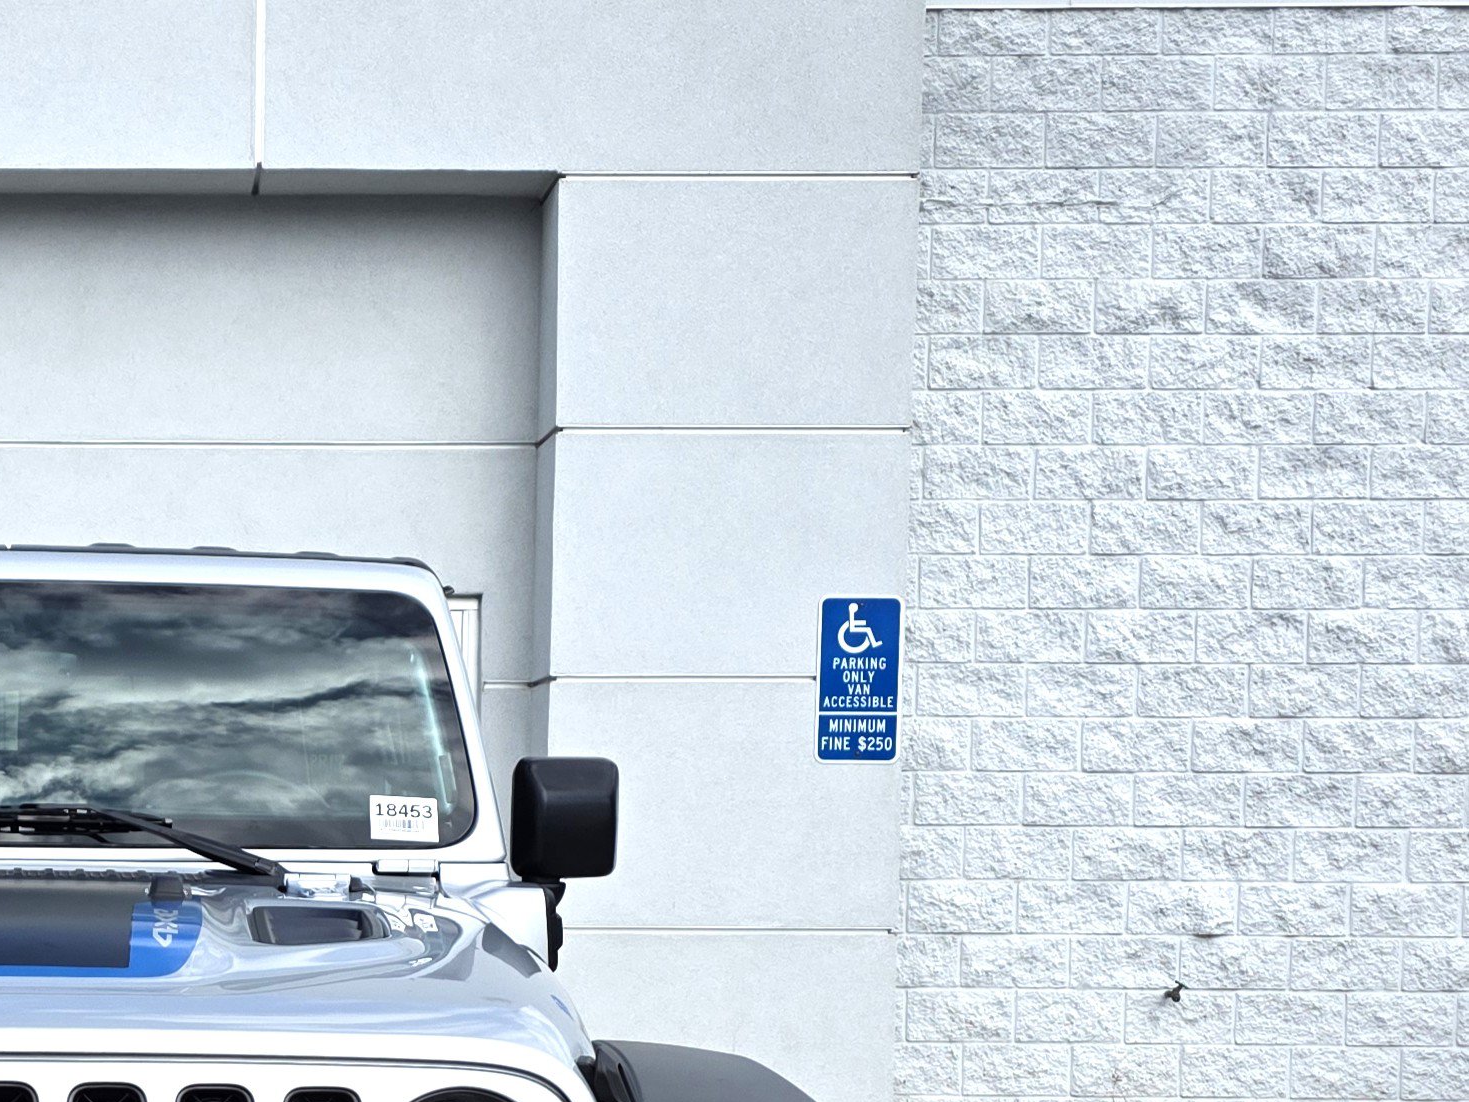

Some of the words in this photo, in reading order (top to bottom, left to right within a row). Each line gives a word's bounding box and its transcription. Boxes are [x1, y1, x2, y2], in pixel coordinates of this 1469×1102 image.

[832, 657, 887, 670] PARKING
[842, 671, 876, 683] ONLY
[847, 684, 871, 696] VAN
[823, 696, 894, 708] ACCESSIBLE
[829, 718, 886, 733] MINIMUM
[821, 736, 851, 751] FINE
[857, 735, 893, 752] $250
[375, 803, 433, 819] 18453
